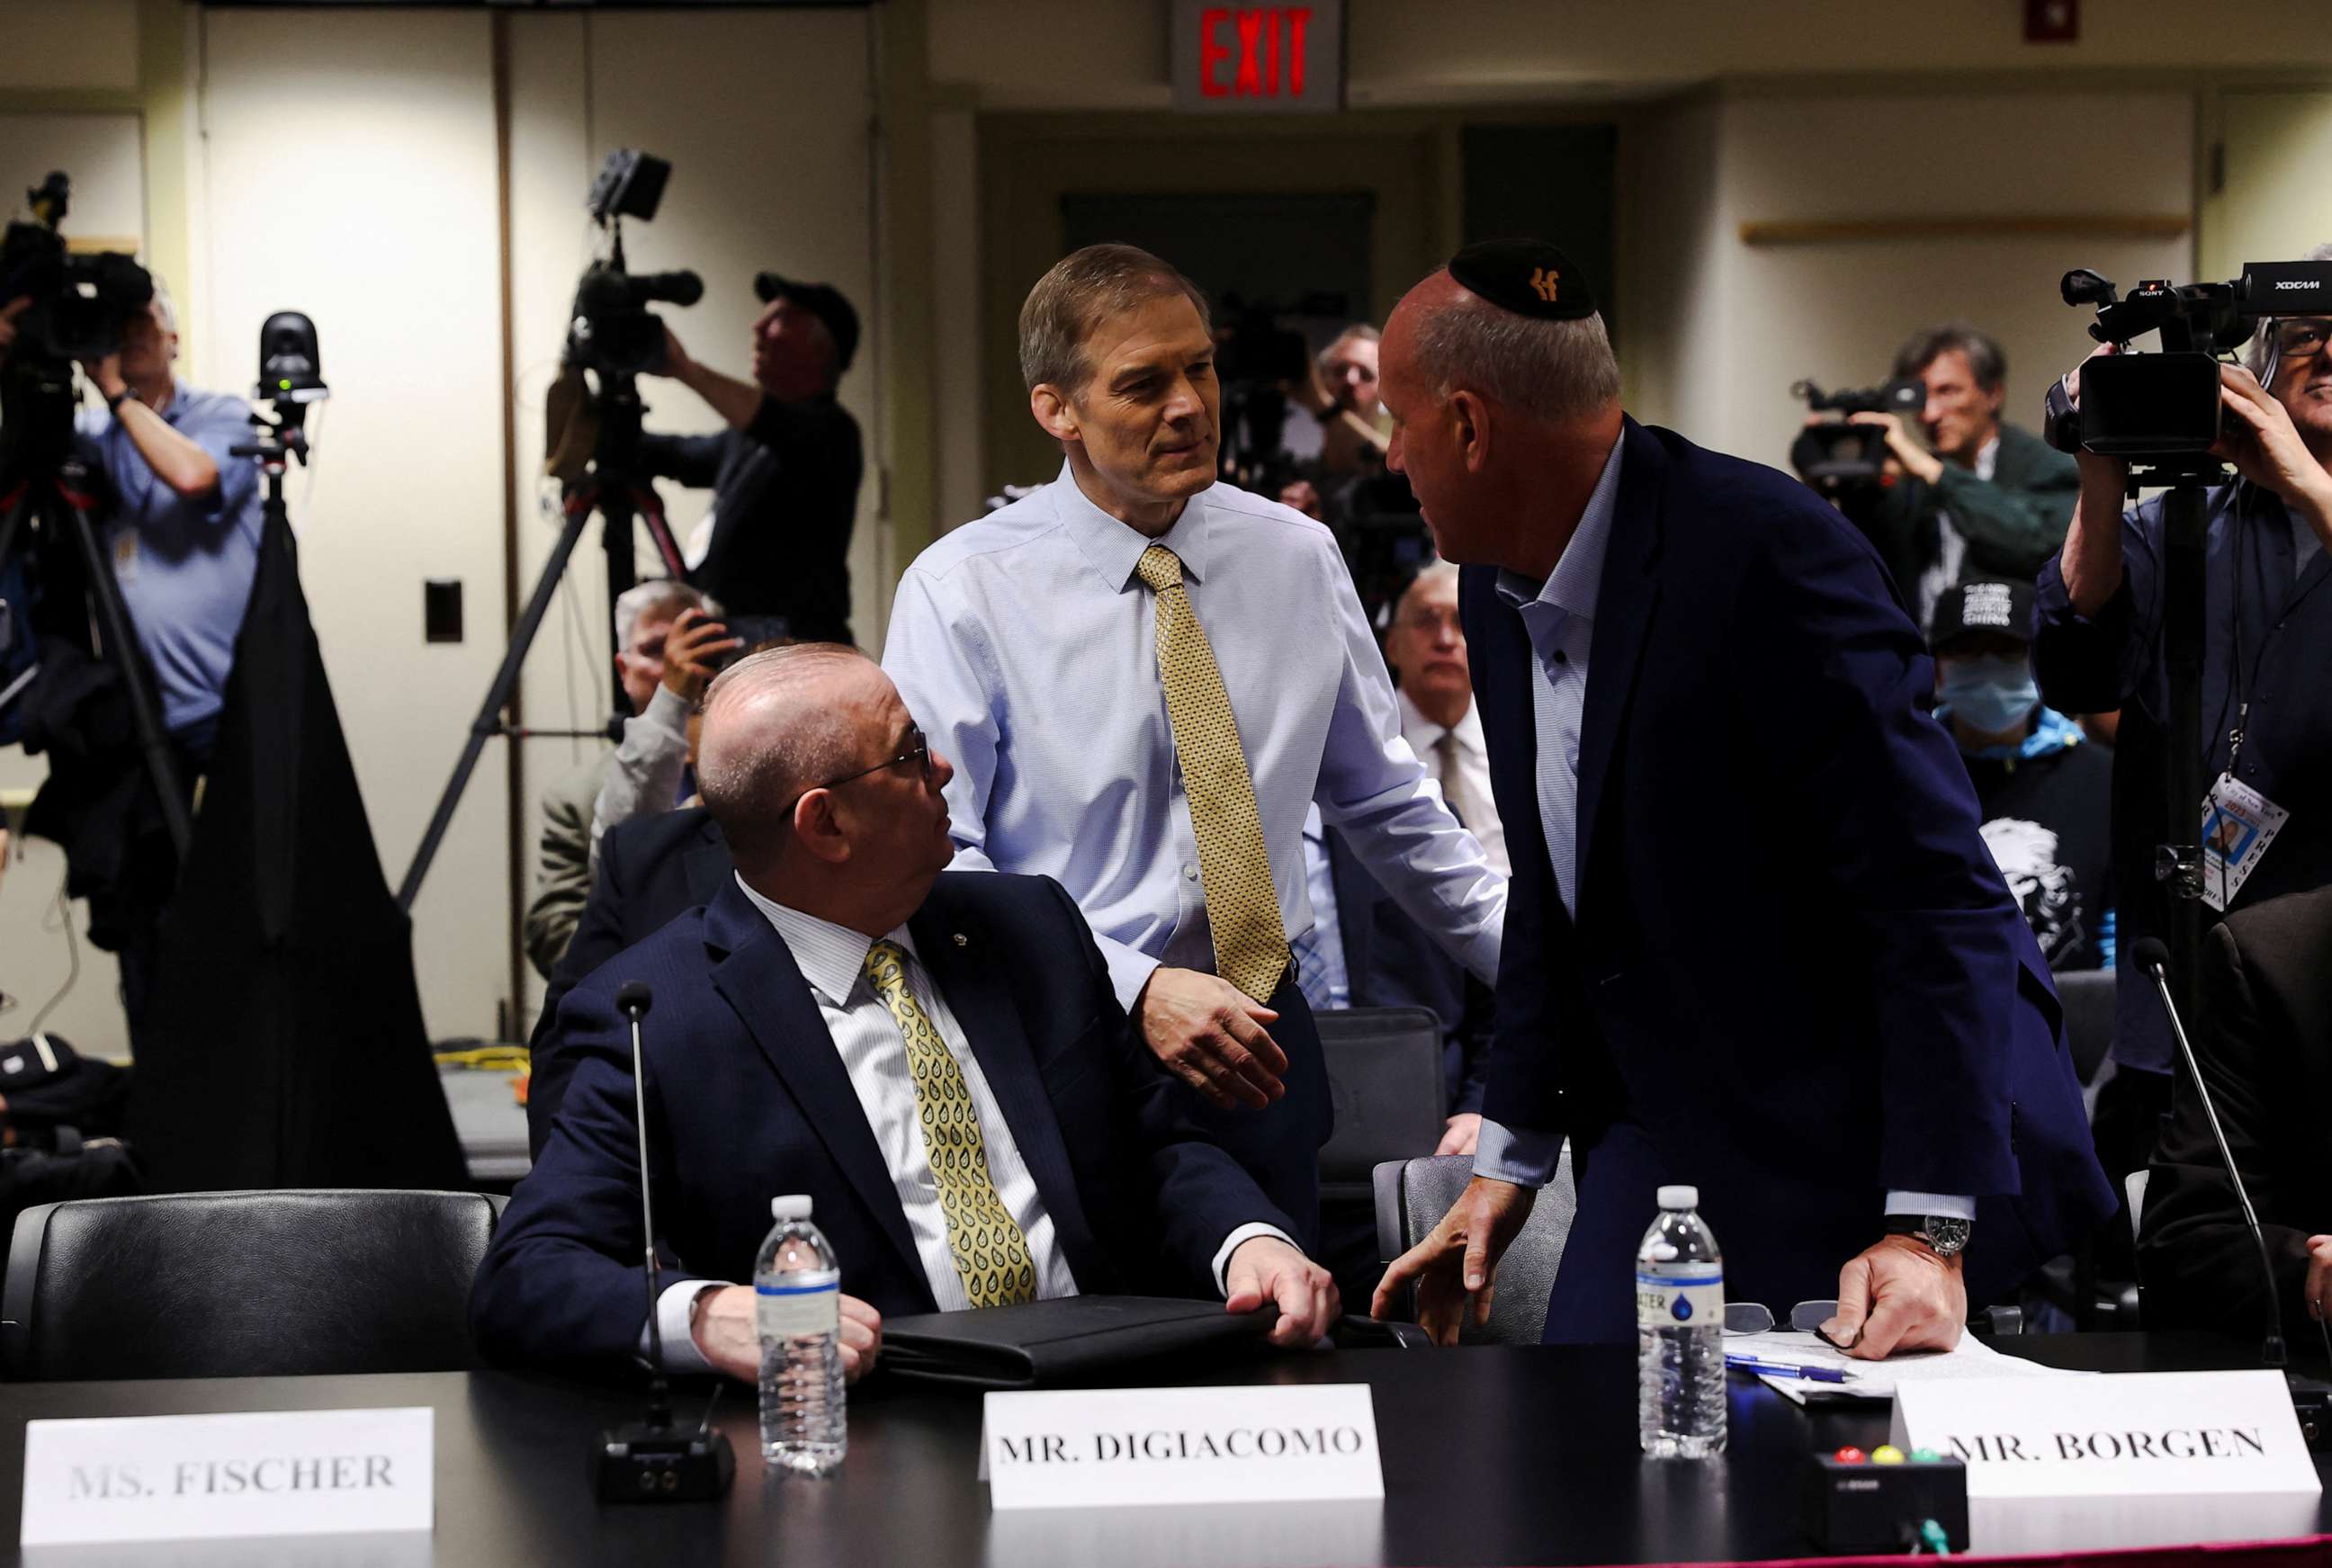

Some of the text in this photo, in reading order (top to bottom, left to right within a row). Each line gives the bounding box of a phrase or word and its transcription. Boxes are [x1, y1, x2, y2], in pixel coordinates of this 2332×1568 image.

[1200, 6, 1314, 98] EXIT
[2275, 280, 2320, 290] XDCAM
[2230, 829, 2274, 887] PRESS
[1000, 1427, 1363, 1464] MR. DIGIACOMO
[1947, 1428, 2265, 1462] MR. BORGEN
[68, 1454, 396, 1500] MS. FISCHER
